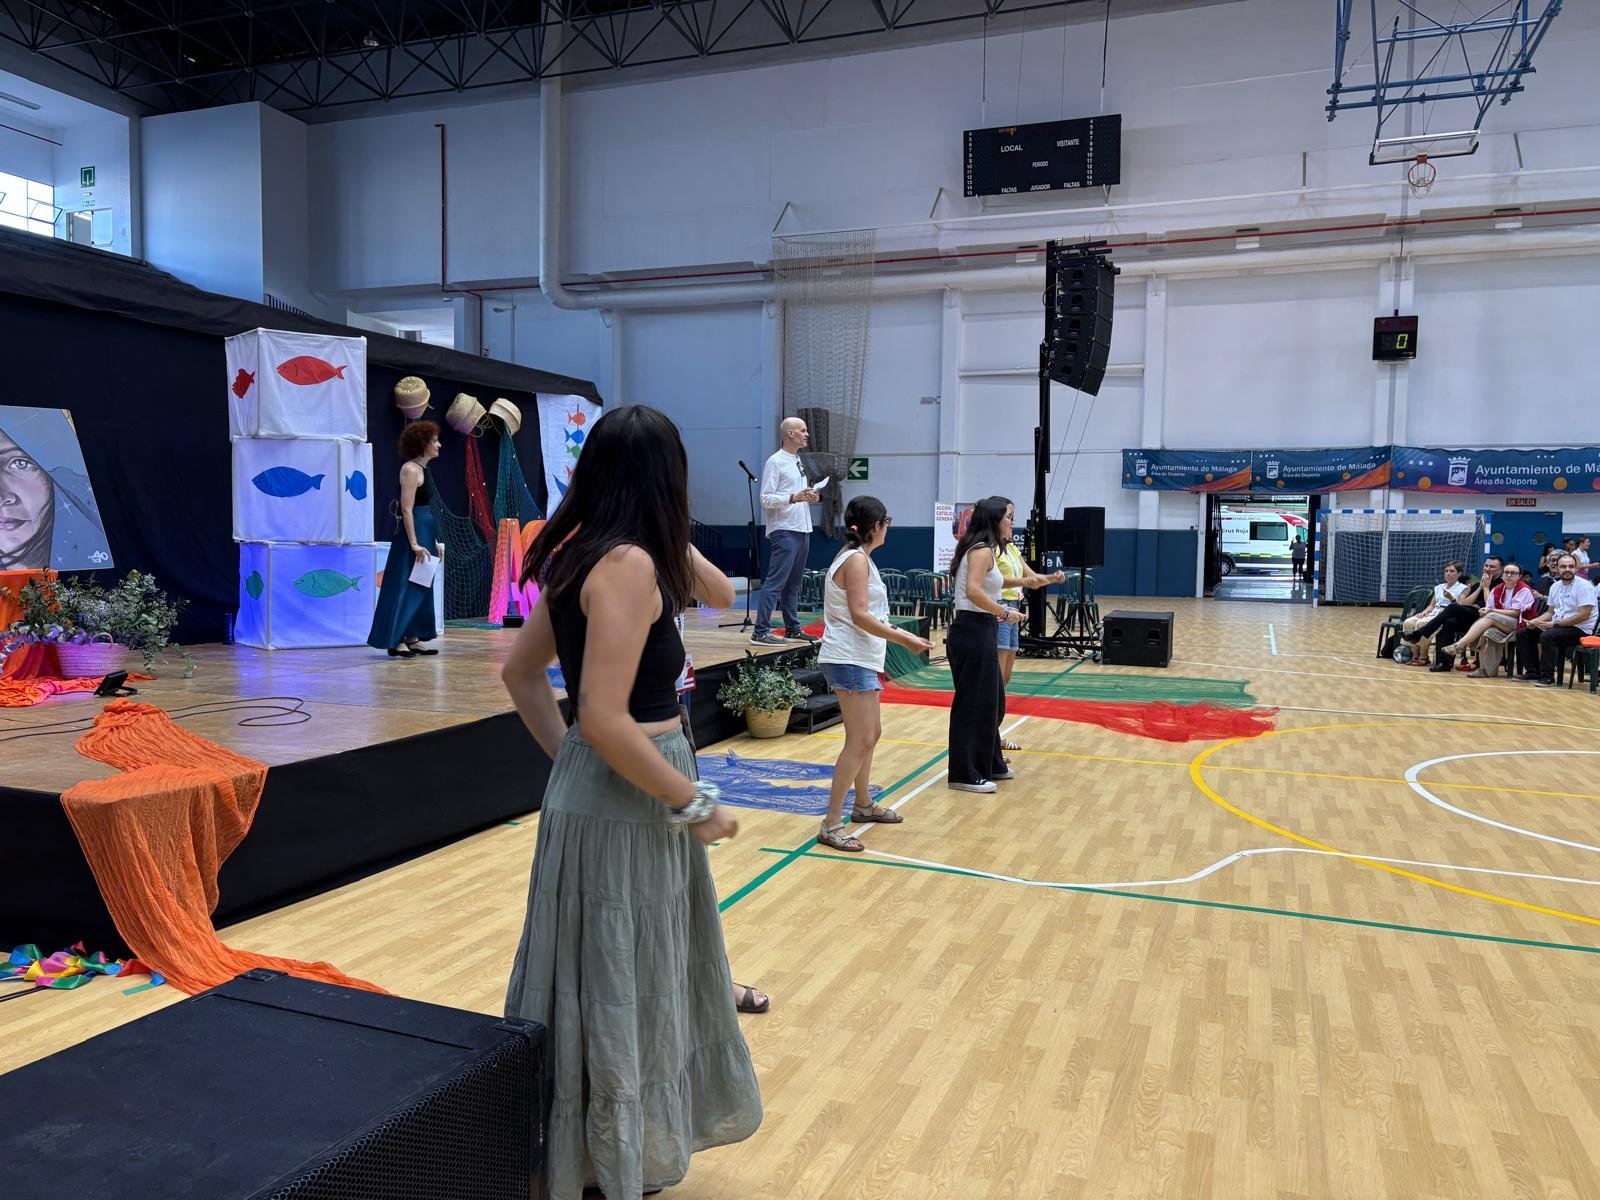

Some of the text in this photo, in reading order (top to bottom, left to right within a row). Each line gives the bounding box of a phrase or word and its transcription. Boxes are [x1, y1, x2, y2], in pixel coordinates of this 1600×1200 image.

[1056, 139, 1080, 147] VISITANTE
[1000, 144, 1023, 152] LOCAL
[1396, 334, 1408, 349] 0
[1151, 464, 1198, 472] Ayuntamiento
[1283, 465, 1334, 473] Ayuntamiento
[1475, 465, 1561, 477] Ayuntamiento
[1566, 464, 1580, 473] de
[1506, 478, 1537, 486] Deporte
